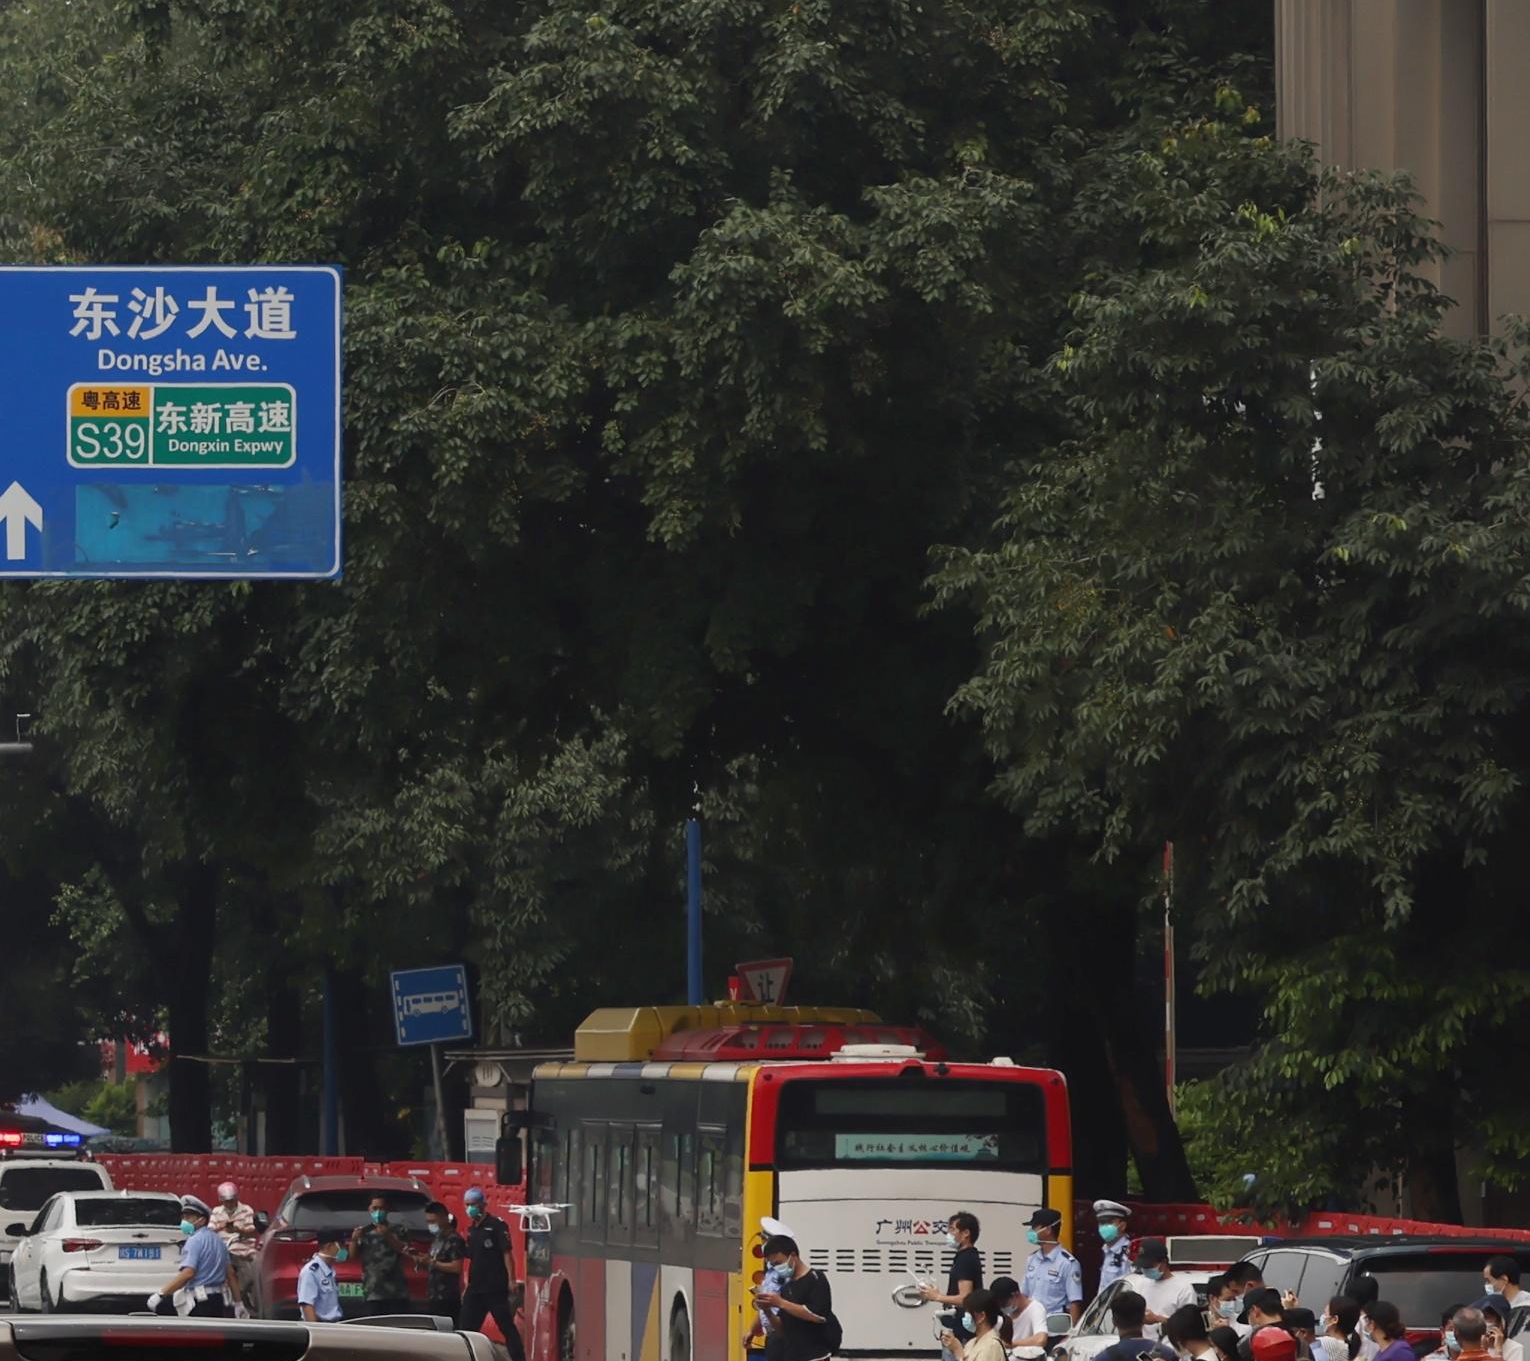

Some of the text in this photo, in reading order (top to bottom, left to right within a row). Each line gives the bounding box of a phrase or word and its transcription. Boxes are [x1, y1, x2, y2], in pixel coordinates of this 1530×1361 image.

[68, 286, 297, 341] 东沙大道
[97, 348, 268, 377] Dongsha Ave.
[80, 391, 142, 412] 粤高速
[156, 401, 293, 436] 东新高速
[75, 424, 146, 461] S39
[168, 439, 284, 457] Dongxin Expwy
